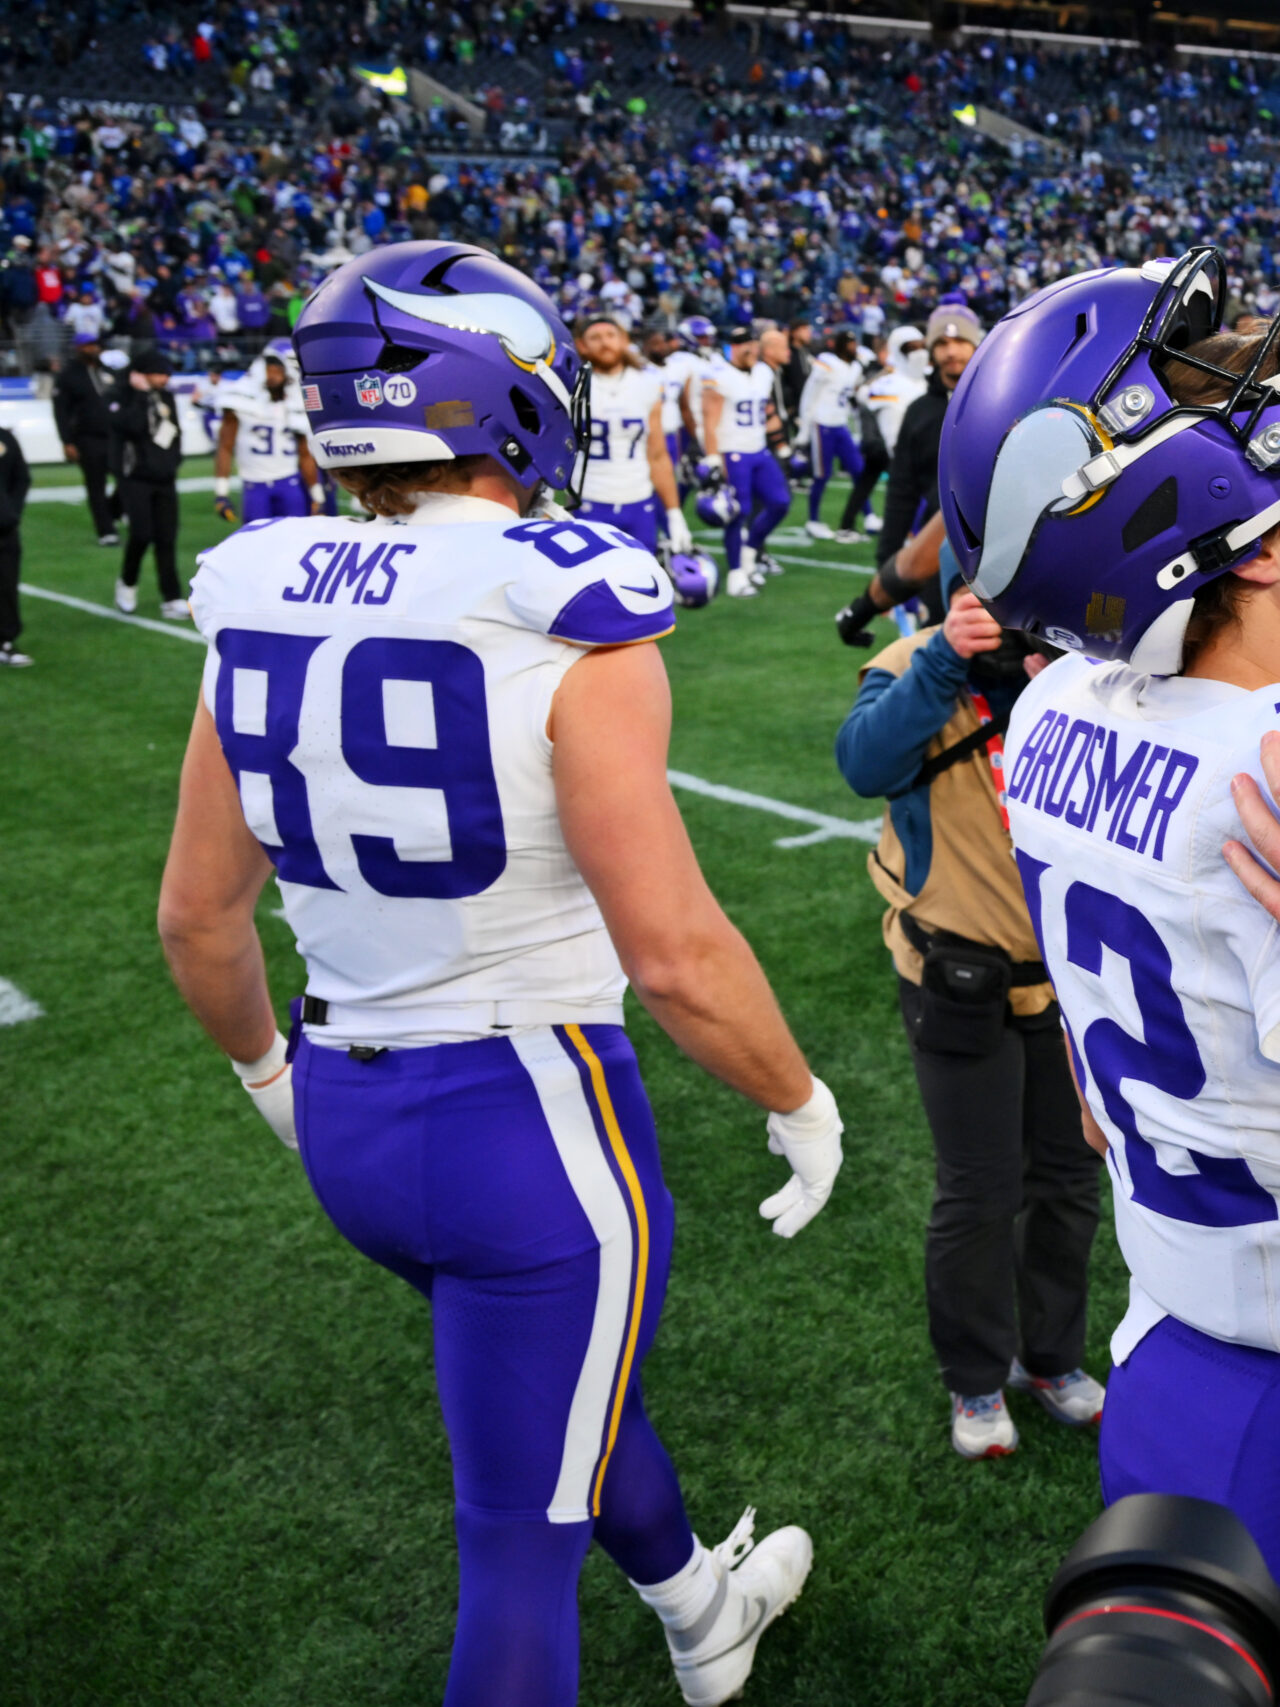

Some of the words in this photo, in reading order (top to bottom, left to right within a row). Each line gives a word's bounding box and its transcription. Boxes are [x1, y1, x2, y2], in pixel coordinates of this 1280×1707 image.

[360, 389, 380, 403] NFL
[388, 382, 412, 400] 70
[588, 418, 645, 460] 87
[282, 542, 416, 605] SIMS
[215, 628, 507, 899] 89
[1008, 709, 1199, 861] BROSMER
